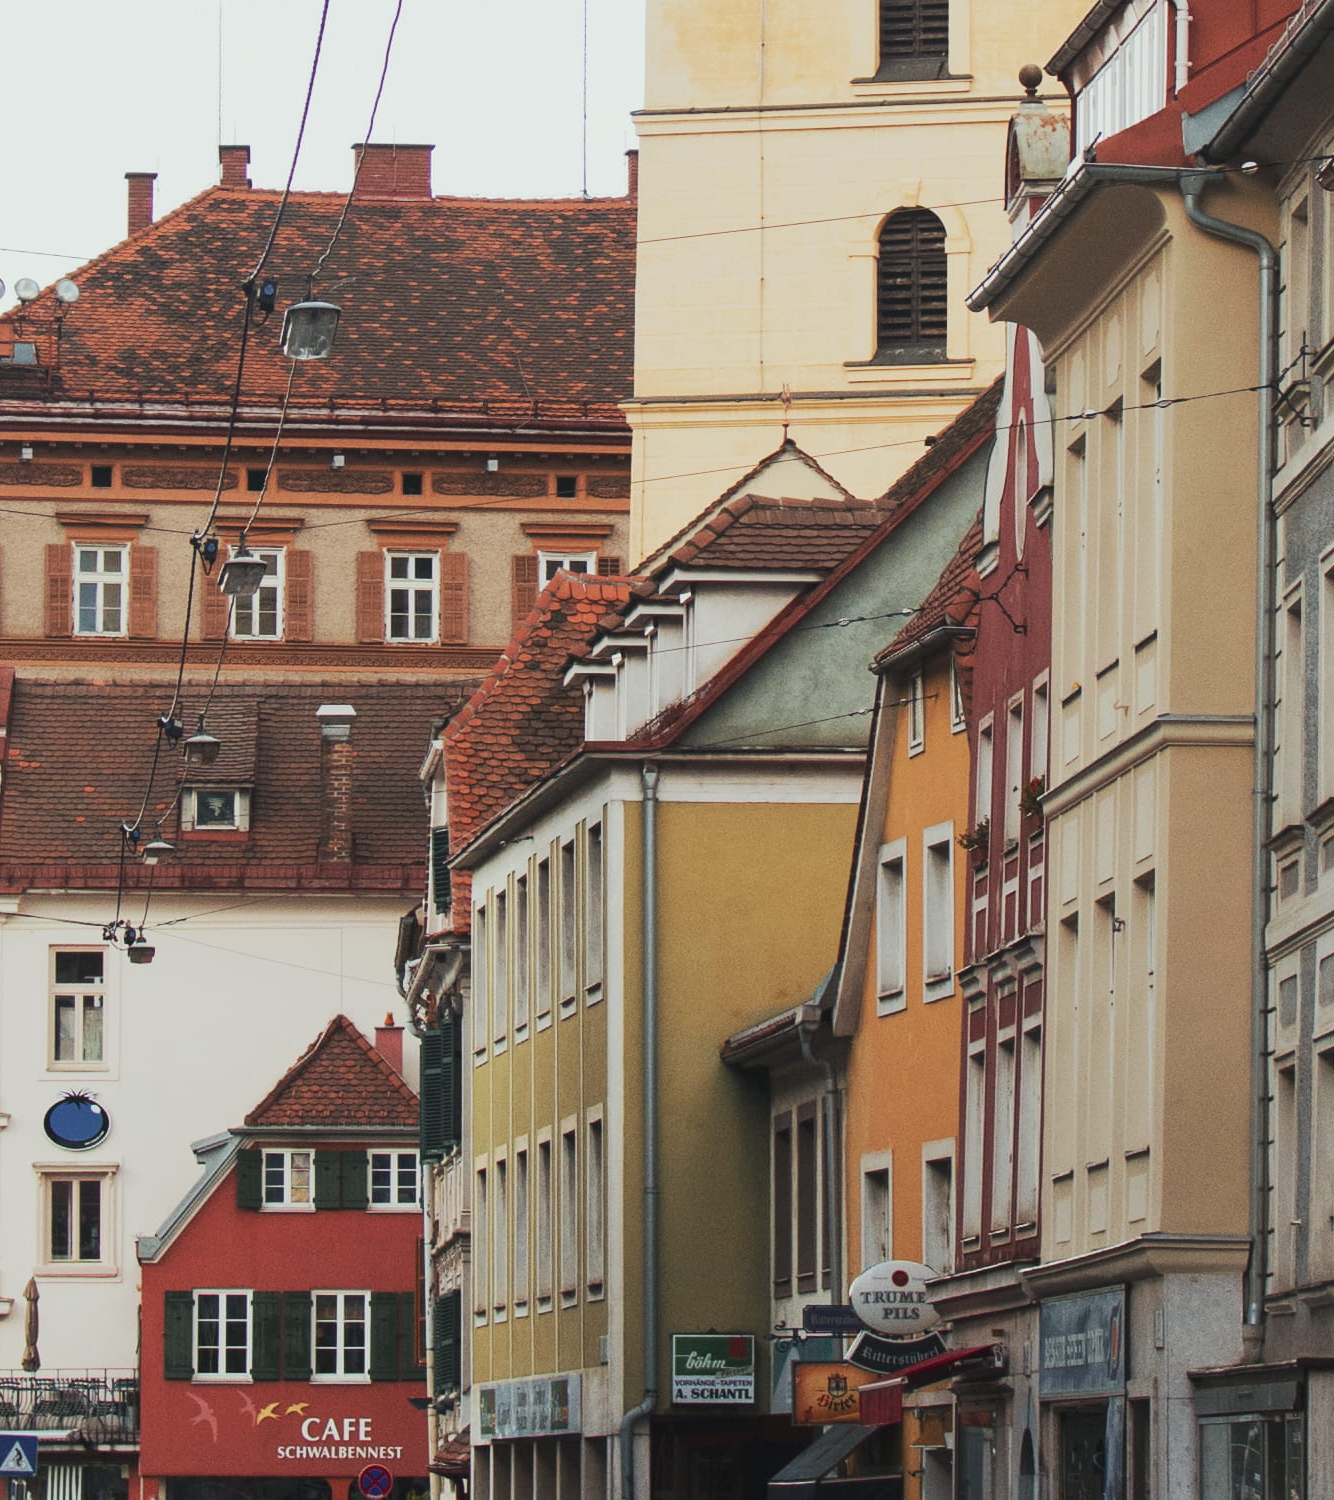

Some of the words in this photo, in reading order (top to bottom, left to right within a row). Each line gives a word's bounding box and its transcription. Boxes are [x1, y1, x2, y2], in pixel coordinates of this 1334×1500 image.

[883, 1307, 920, 1320] PILS
[686, 1351, 726, 1369] böhm
[675, 1388, 687, 1399] A.
[691, 1388, 752, 1399] SCHANTL
[301, 1417, 372, 1441] CAFE
[277, 1446, 403, 1459] SCHWALBENNEST
